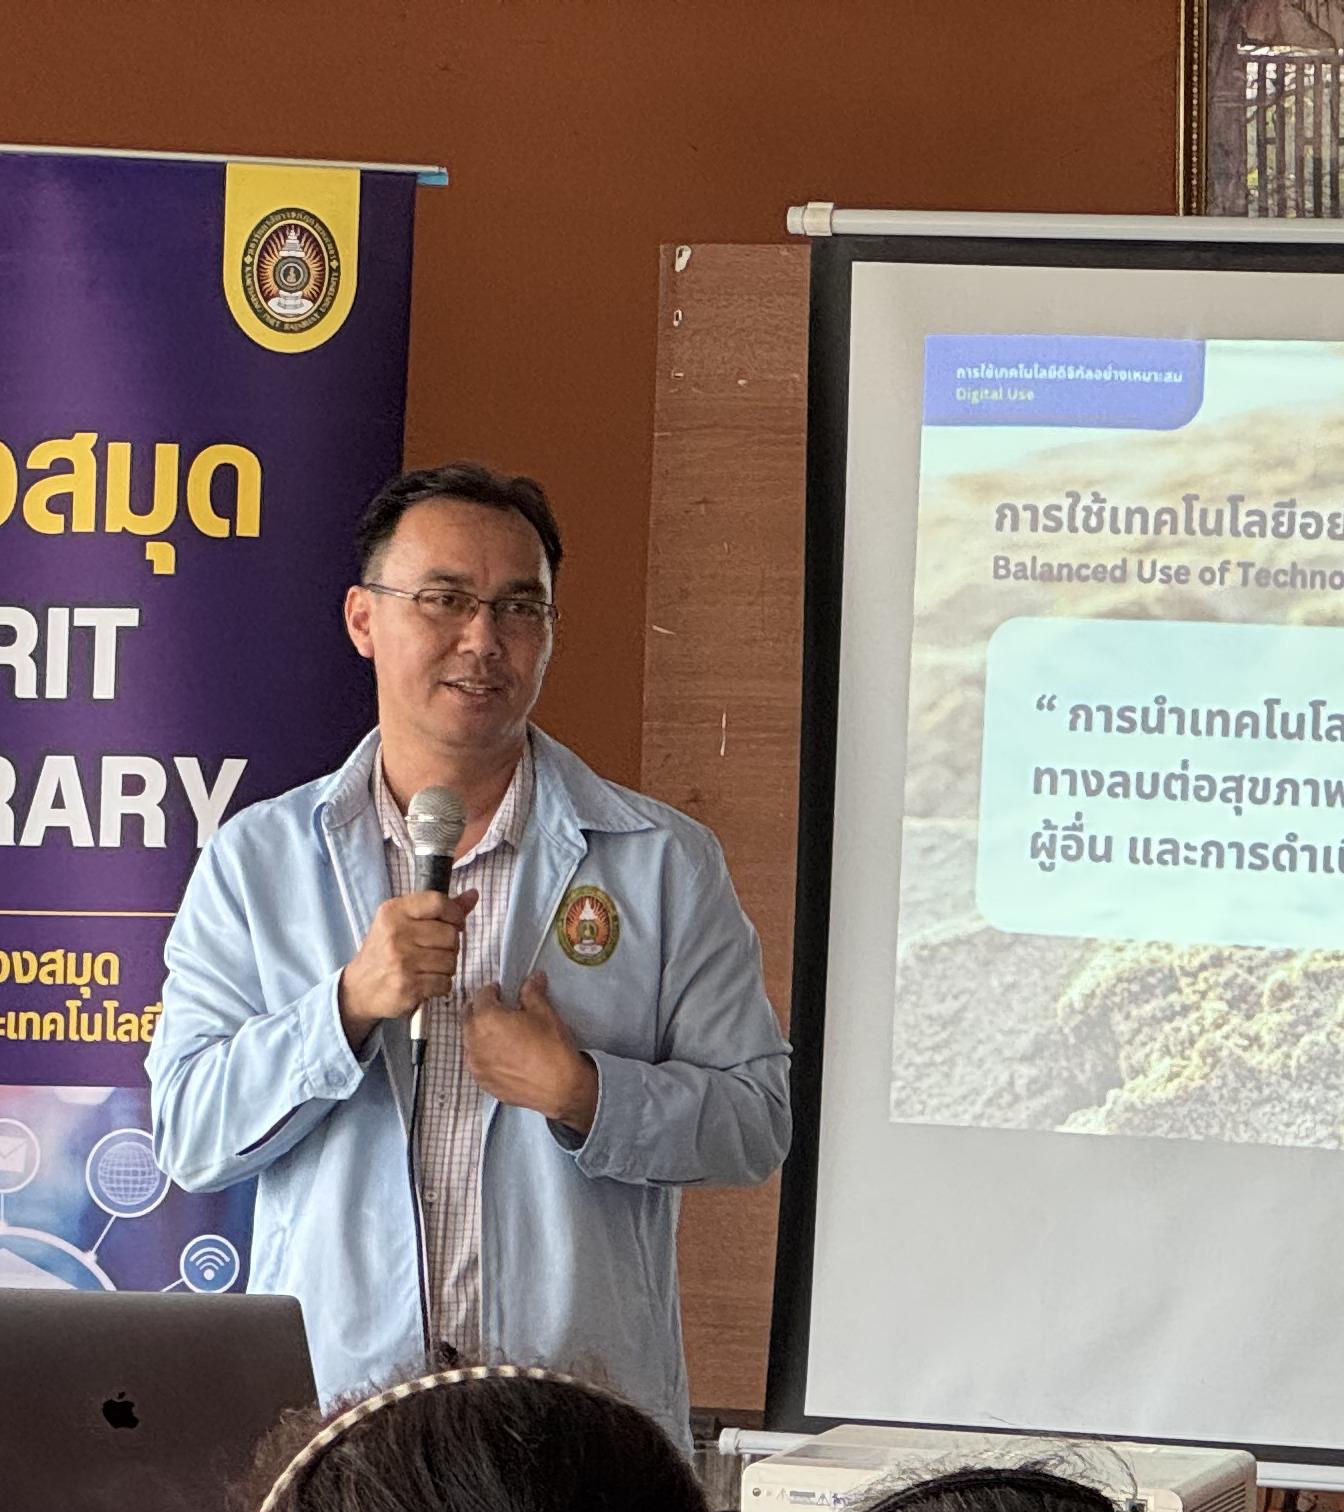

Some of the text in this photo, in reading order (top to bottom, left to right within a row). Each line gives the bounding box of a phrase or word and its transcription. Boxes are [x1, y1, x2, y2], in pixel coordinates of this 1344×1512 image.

[955, 386, 1035, 404] Digital Use
[992, 555, 1127, 584] Balanced
[1136, 558, 1192, 585] Use
[1198, 560, 1232, 587] of
[1030, 811, 1114, 872] ผู้อื่น
